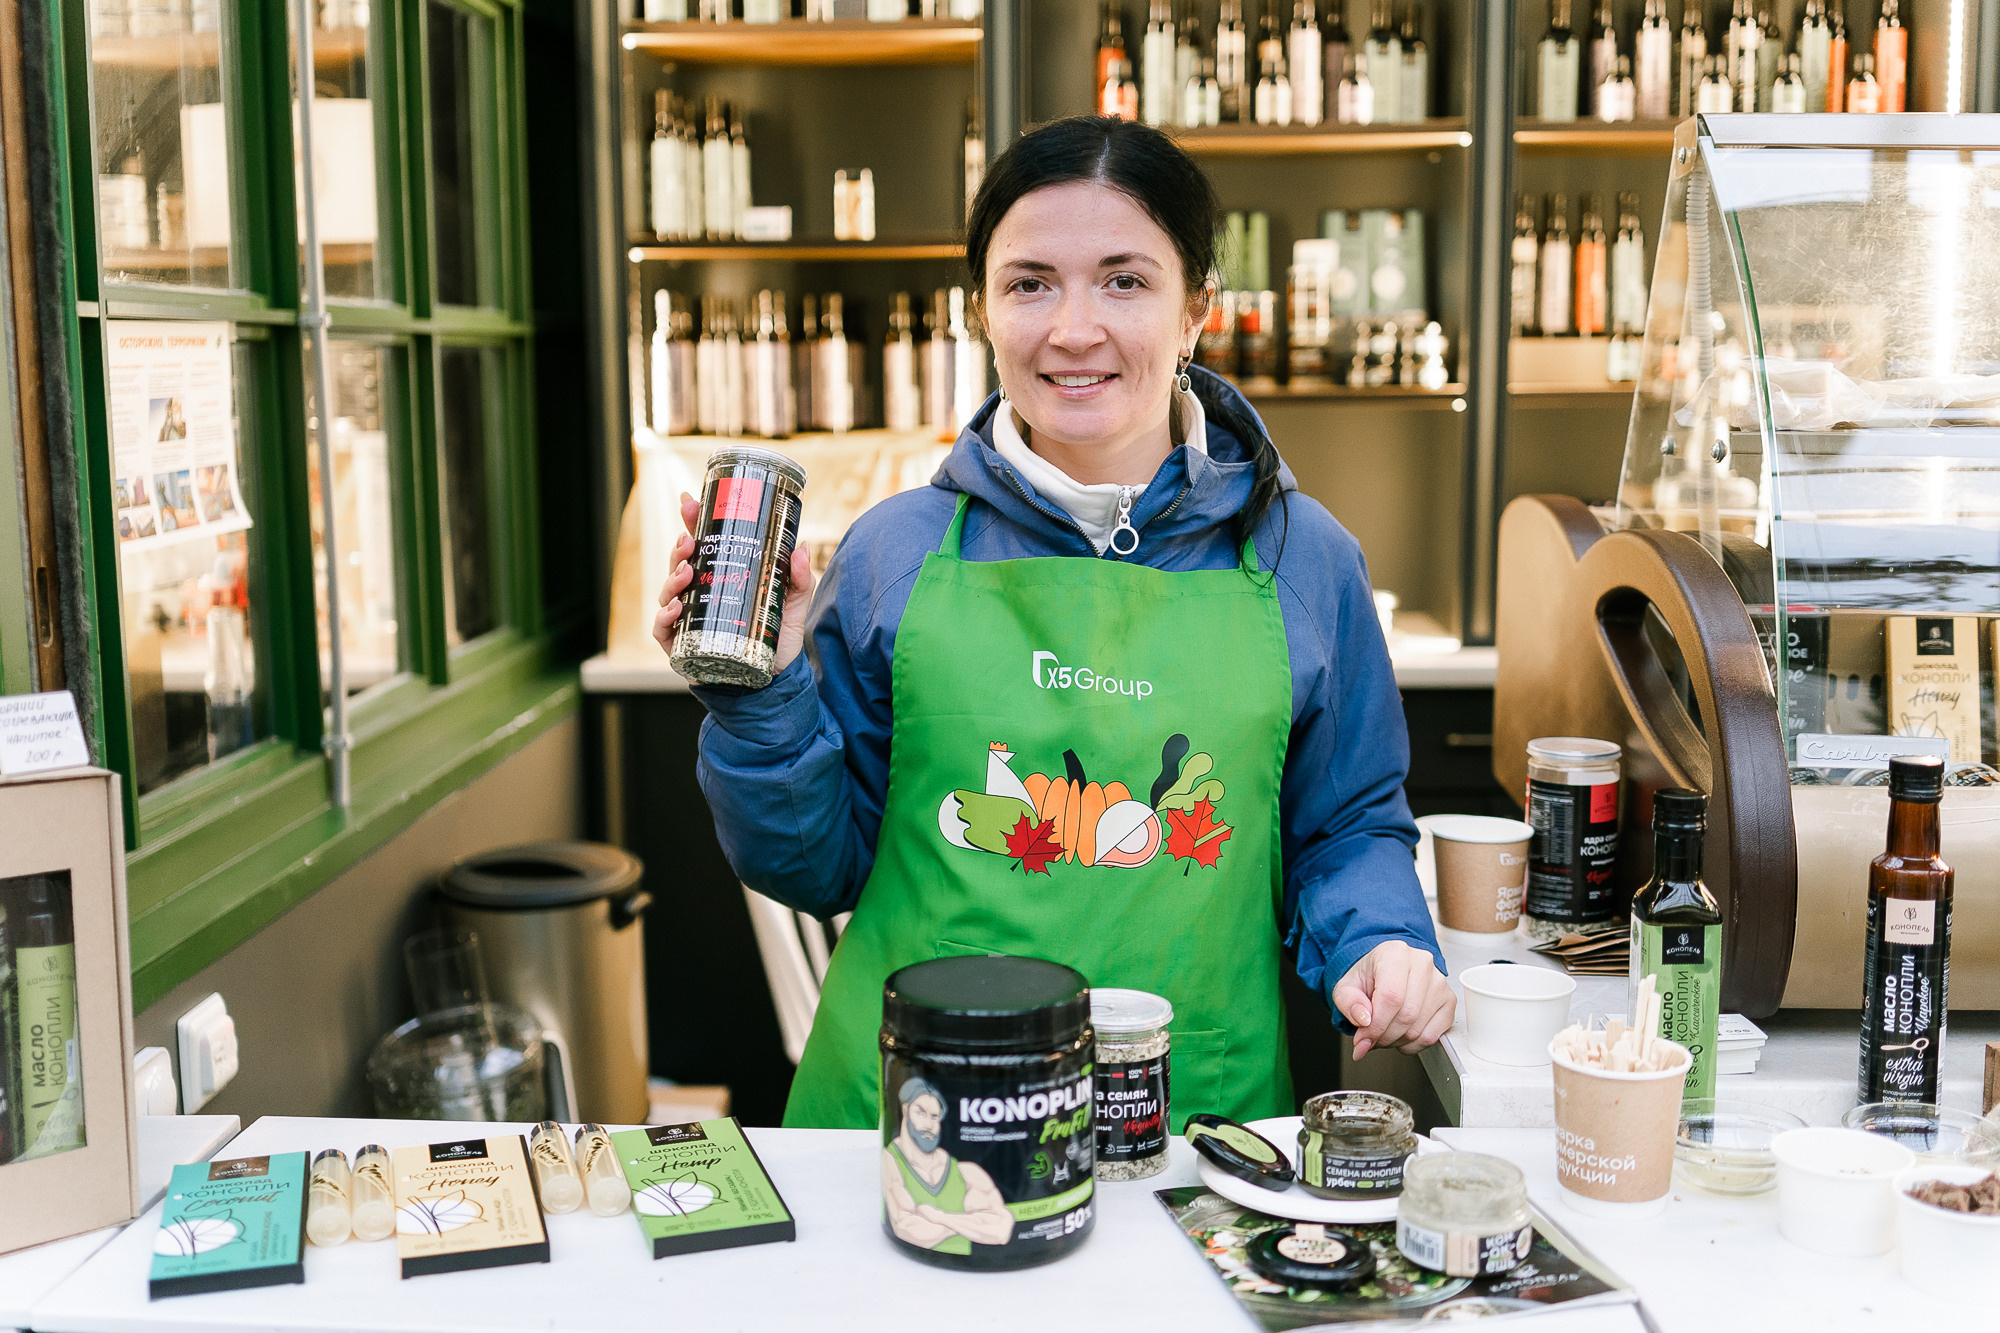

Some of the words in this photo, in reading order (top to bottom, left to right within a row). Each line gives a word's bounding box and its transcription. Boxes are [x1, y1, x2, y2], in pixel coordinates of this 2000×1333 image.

[704, 533, 728, 547] ядра
[728, 534, 761, 546] семян
[699, 543, 763, 560] КОНОПЛИ
[706, 559, 747, 568] очищенные
[1901, 672, 1972, 685] КОНОПЛИ
[1890, 923, 1930, 933] КОНОПЕЛЬ
[1666, 946, 1701, 955] КОНОПЕЛЬ
[1883, 974, 1898, 1033] масло
[1899, 954, 1916, 1035] КОНОПЛИ
[1676, 969, 1689, 1042] КОНОПЛИ
[1663, 991, 1674, 1041] масло
[46, 995, 64, 1087] КОНОПЛИ
[30, 1023, 46, 1088] масло
[1885, 1056, 1924, 1074] extra
[1883, 1070, 1925, 1090] virgin
[959, 1075, 1093, 1124] KONOPLIN
[1107, 1089, 1149, 1101] семян
[1096, 1099, 1157, 1119] НОПЛИ
[654, 1132, 701, 1142] КОНОПЕЛЬ
[1556, 1126, 1595, 1151] арка
[435, 1150, 483, 1159] КОНОПЕЛЬ
[636, 1145, 738, 1164] КОНОПЛИ
[649, 1141, 717, 1155] шоколад
[425, 1161, 495, 1172] шоколад
[652, 1157, 723, 1175] Hemp
[1557, 1143, 1636, 1172] мерской
[213, 1167, 264, 1177] КОНОПЕЛЬ
[408, 1163, 515, 1181] КОНОПЛИ
[1325, 1165, 1360, 1179] СЕМЕНА
[1557, 1156, 1618, 1186] дукции
[182, 1181, 290, 1199] КОНОПЛИ
[200, 1178, 272, 1190] шоколад
[418, 1175, 501, 1192] Honey
[1326, 1177, 1356, 1189] урбеч
[184, 1190, 284, 1212] Coconut
